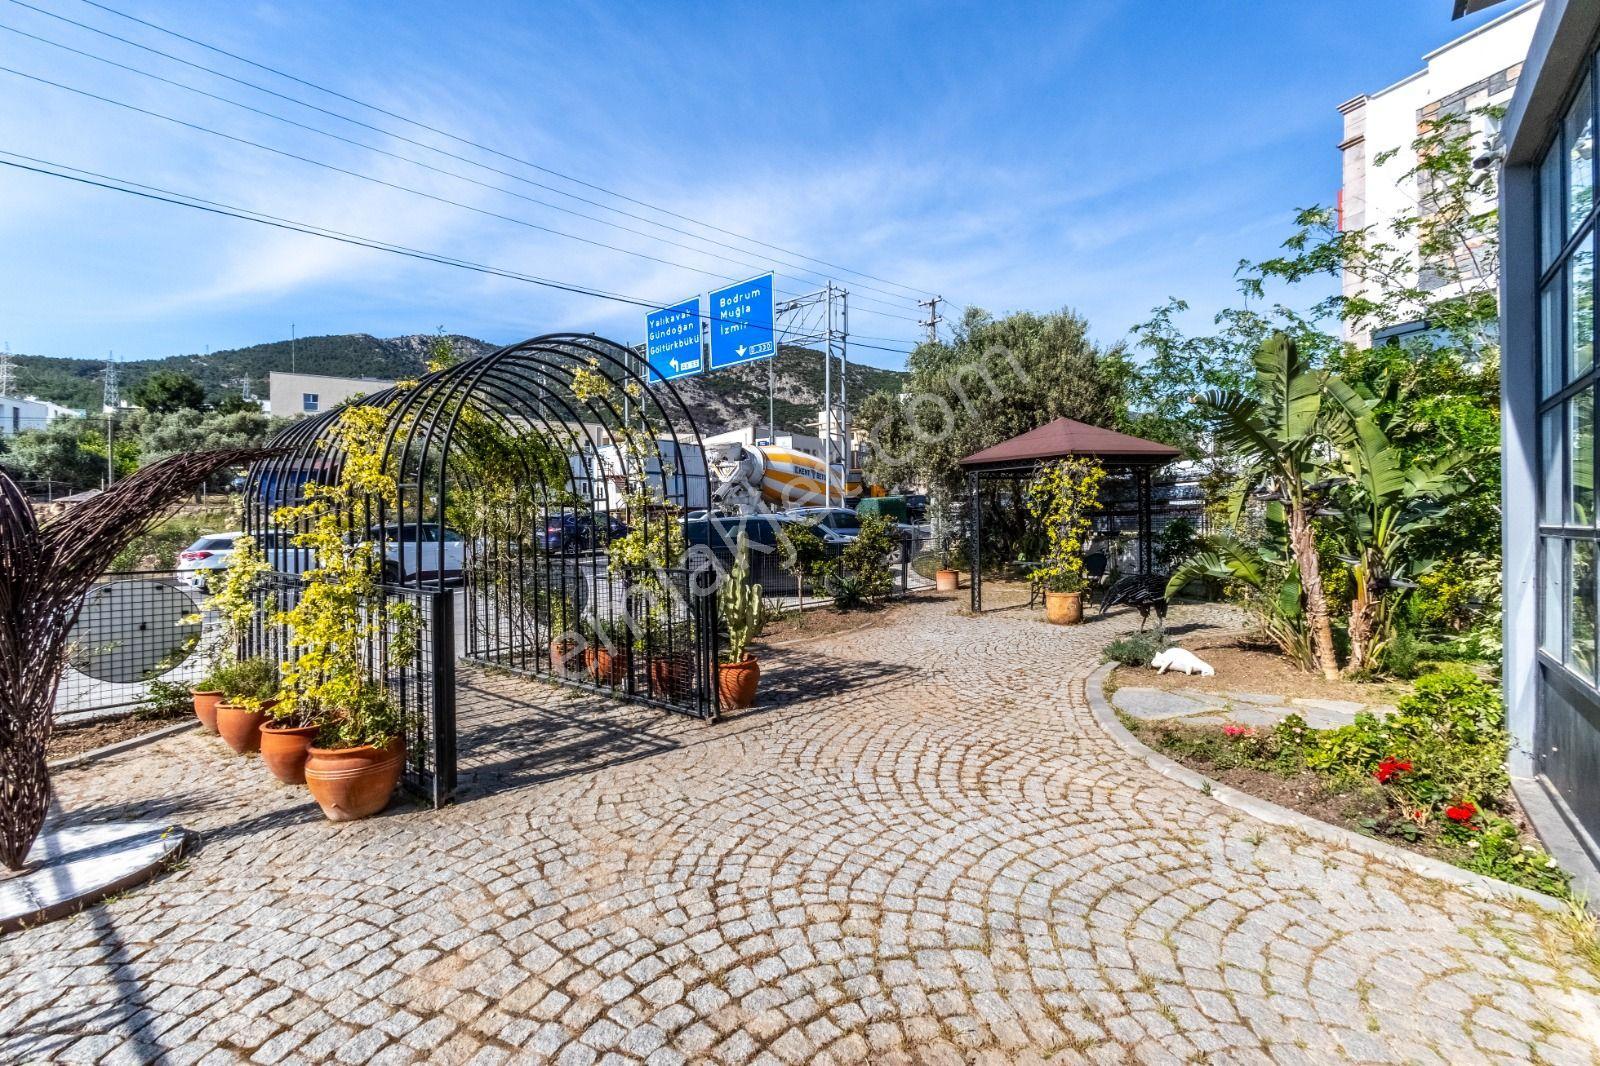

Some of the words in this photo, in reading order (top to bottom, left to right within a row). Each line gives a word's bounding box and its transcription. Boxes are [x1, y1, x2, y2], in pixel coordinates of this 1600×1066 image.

[720, 289, 760, 308] Bodrum
[650, 309, 691, 329] Yalıkavak
[720, 305, 751, 320] Muğla
[649, 322, 694, 341] Gündoğan
[720, 322, 748, 336] İzmir
